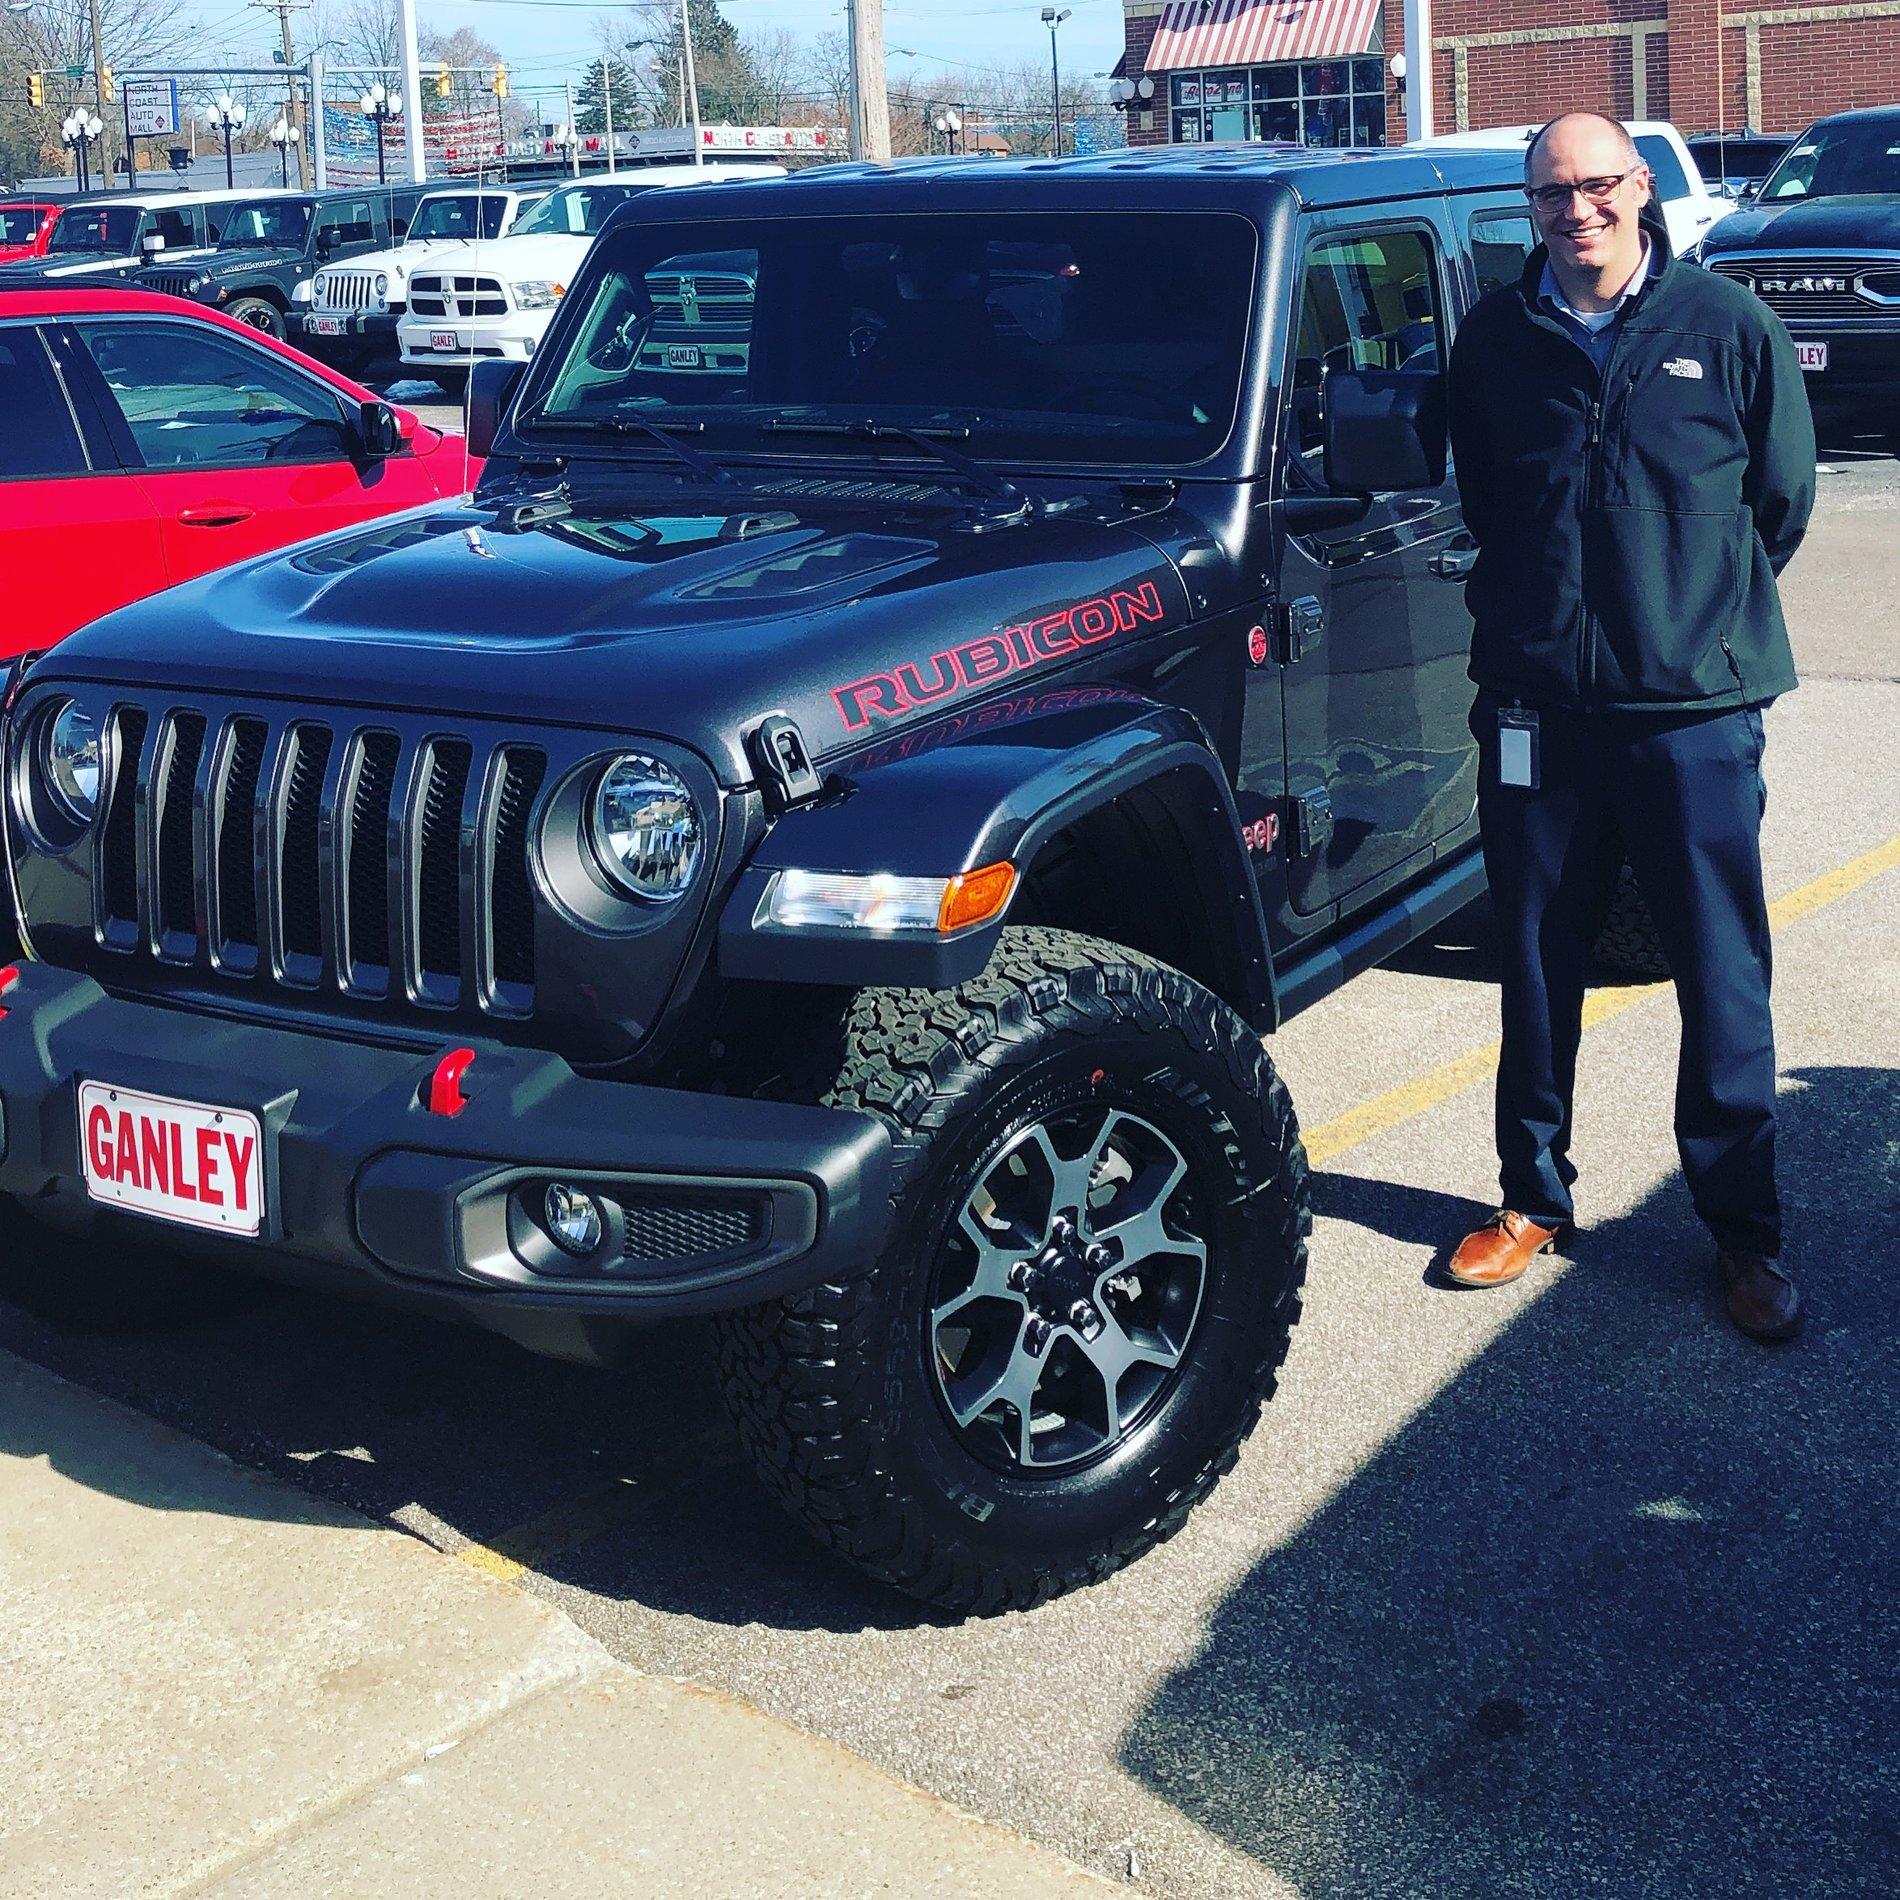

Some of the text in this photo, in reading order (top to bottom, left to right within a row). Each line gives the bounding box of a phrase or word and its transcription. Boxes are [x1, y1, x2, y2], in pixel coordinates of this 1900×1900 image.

[128, 85, 158, 94] NORTH
[129, 97, 158, 107] COAST
[130, 111, 153, 120] AUTO
[130, 124, 153, 133] MALL
[585, 135, 626, 151] MAL
[1762, 278, 1845, 291] RAM
[433, 335, 455, 347] GANLEY
[670, 349, 698, 363] GANLEY
[830, 581, 1164, 732] RUBICON
[1241, 812, 1280, 854] eep
[88, 1104, 254, 1211] GANLEY
